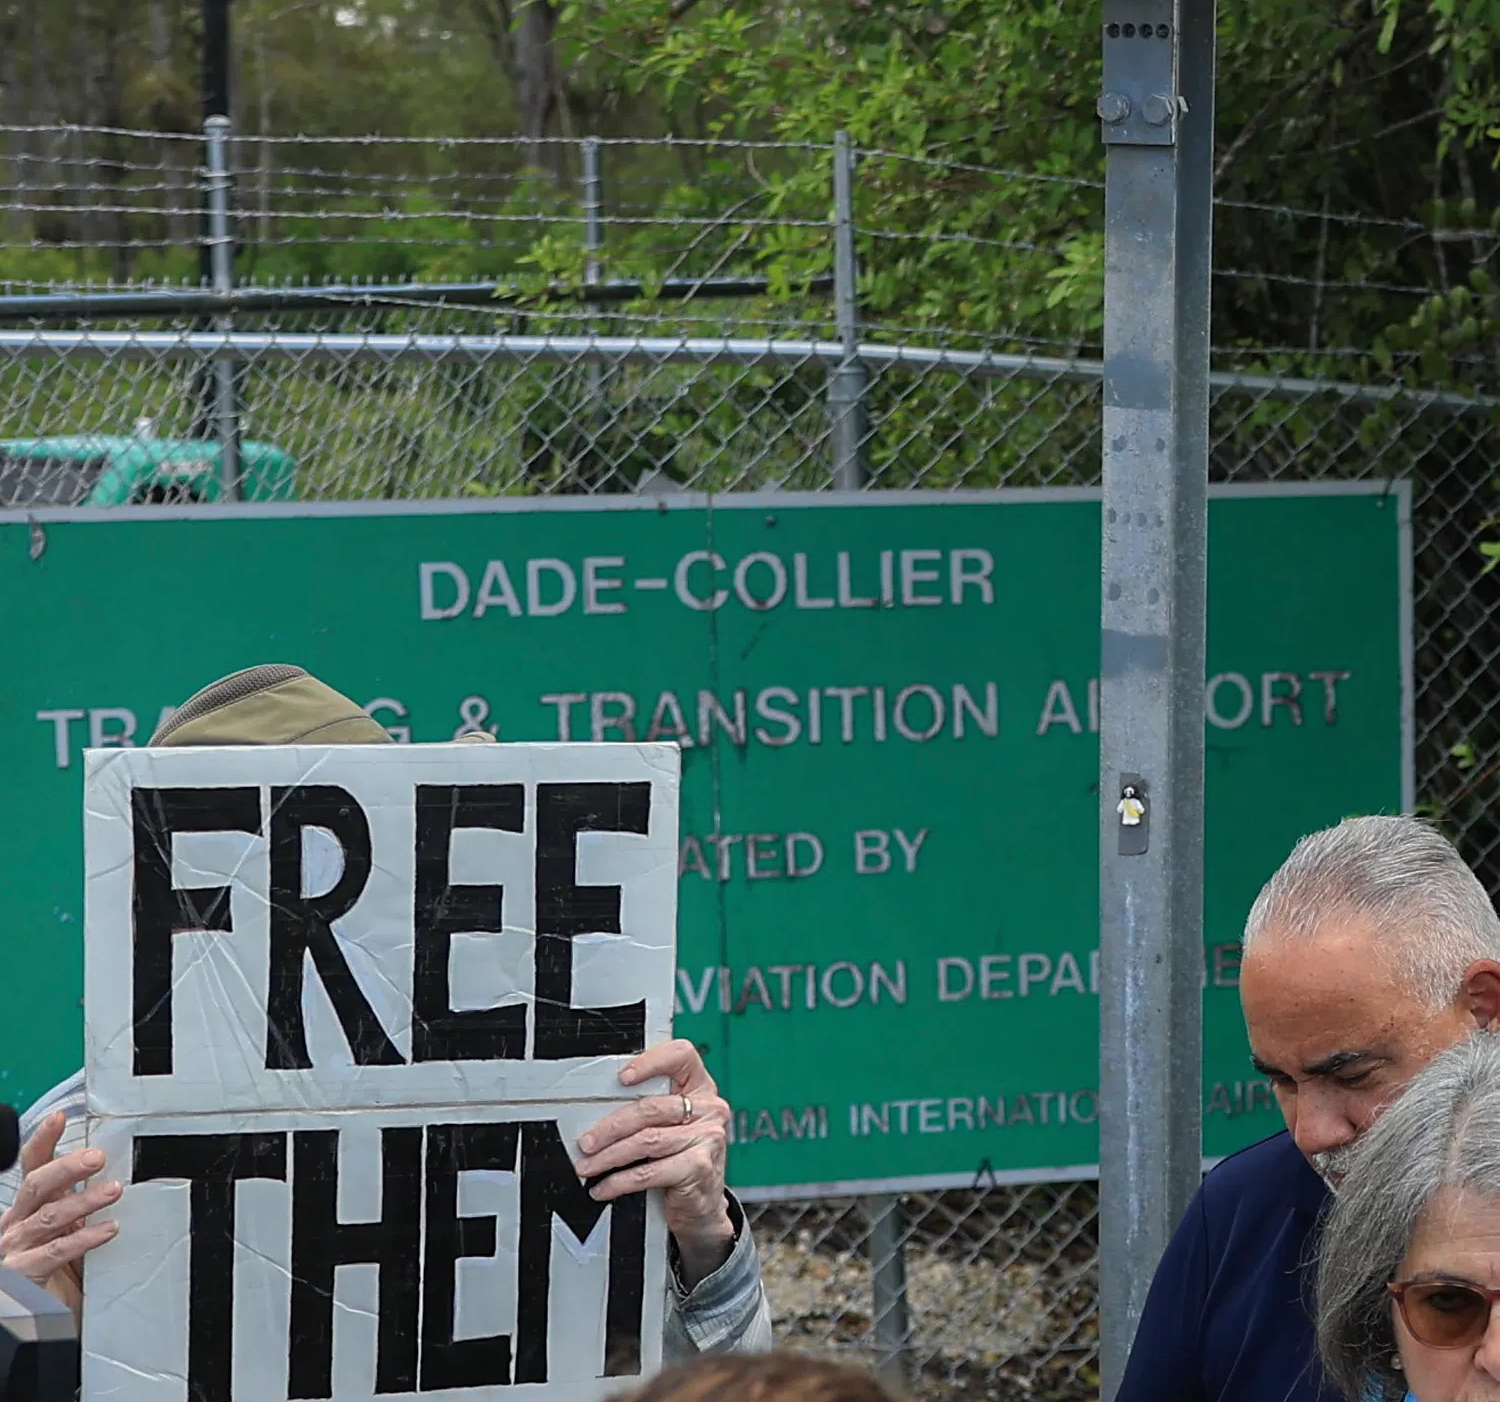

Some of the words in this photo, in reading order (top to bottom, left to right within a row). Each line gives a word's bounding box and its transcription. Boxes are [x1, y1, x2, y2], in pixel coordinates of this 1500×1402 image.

[419, 549, 996, 621] DADE-COLLIER
[541, 681, 1000, 748] TRANSITION
[1036, 670, 1352, 737] AIORT
[678, 830, 825, 883] ATED
[854, 827, 929, 875] BY
[130, 781, 652, 1077] FREE
[673, 959, 907, 1016] VIATION
[849, 1089, 1100, 1135] INTERNATIO
